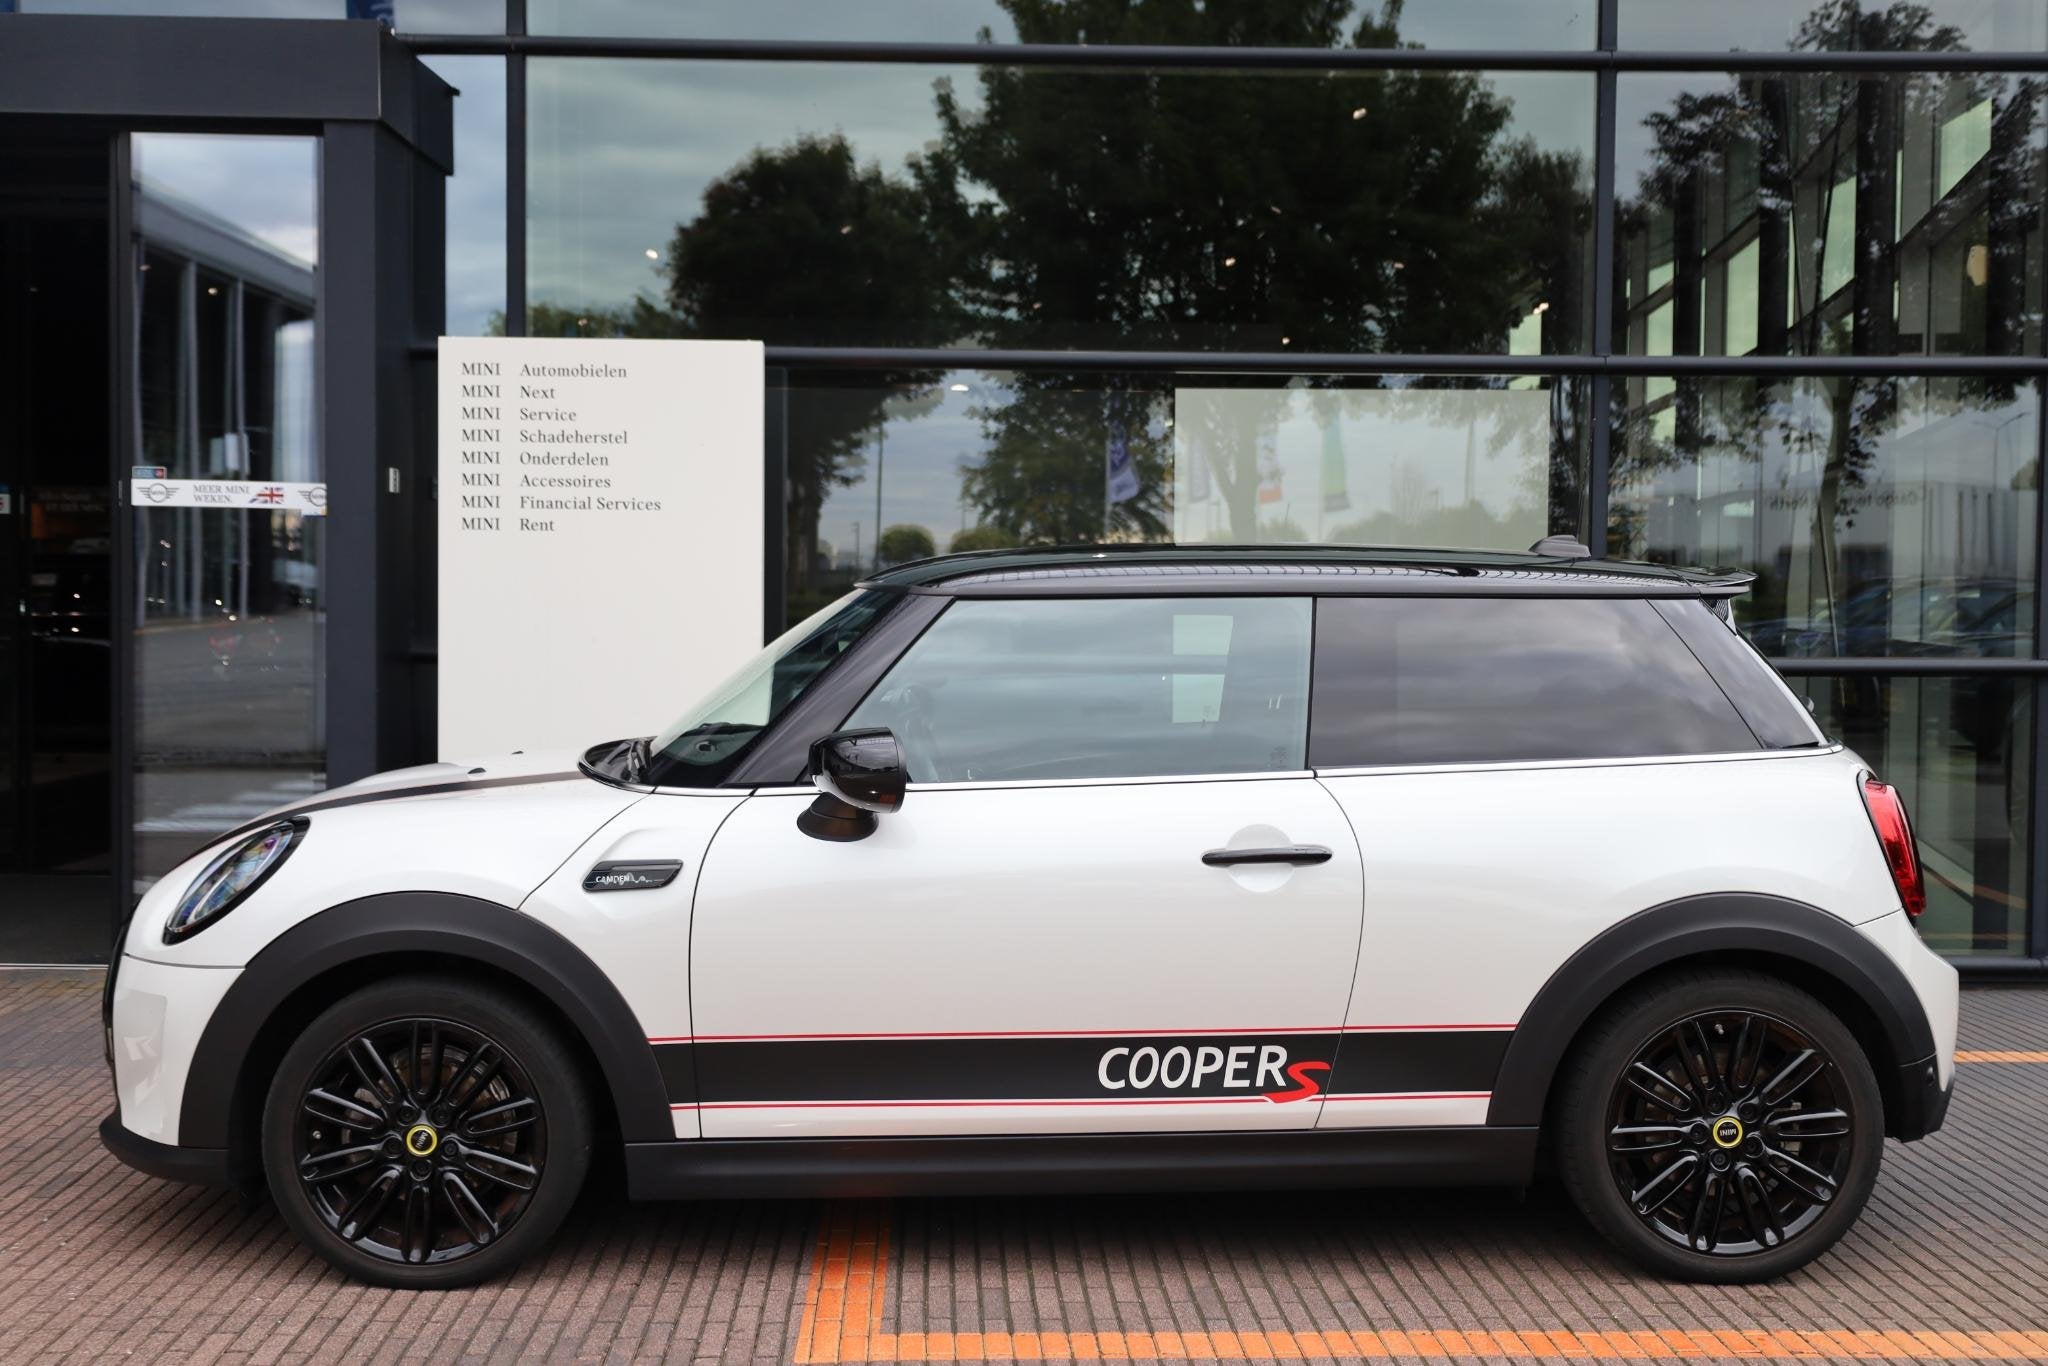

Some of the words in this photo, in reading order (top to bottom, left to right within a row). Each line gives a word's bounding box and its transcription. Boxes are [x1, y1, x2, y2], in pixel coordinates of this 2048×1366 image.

[461, 362, 501, 376] MINI
[519, 364, 628, 378] Automobielen
[461, 384, 501, 399] MINI
[519, 385, 556, 400] Next
[461, 406, 501, 421] MINI
[519, 407, 577, 422] Service
[461, 428, 501, 443] MINI
[519, 429, 629, 445] Schadeherstel
[461, 450, 501, 465] MINI
[519, 452, 610, 466] Onderdelen
[461, 472, 501, 487] MINI
[519, 473, 612, 488] Accessoires
[193, 484, 222, 494] MEER
[226, 485, 250, 495] MINI
[461, 494, 501, 509] MINI
[519, 495, 592, 510] Financial
[596, 497, 662, 511] Services
[461, 516, 501, 531] MINI
[519, 518, 555, 532] Rent
[1097, 1045, 1288, 1090] COOPER
[1261, 1061, 1332, 1104] S
